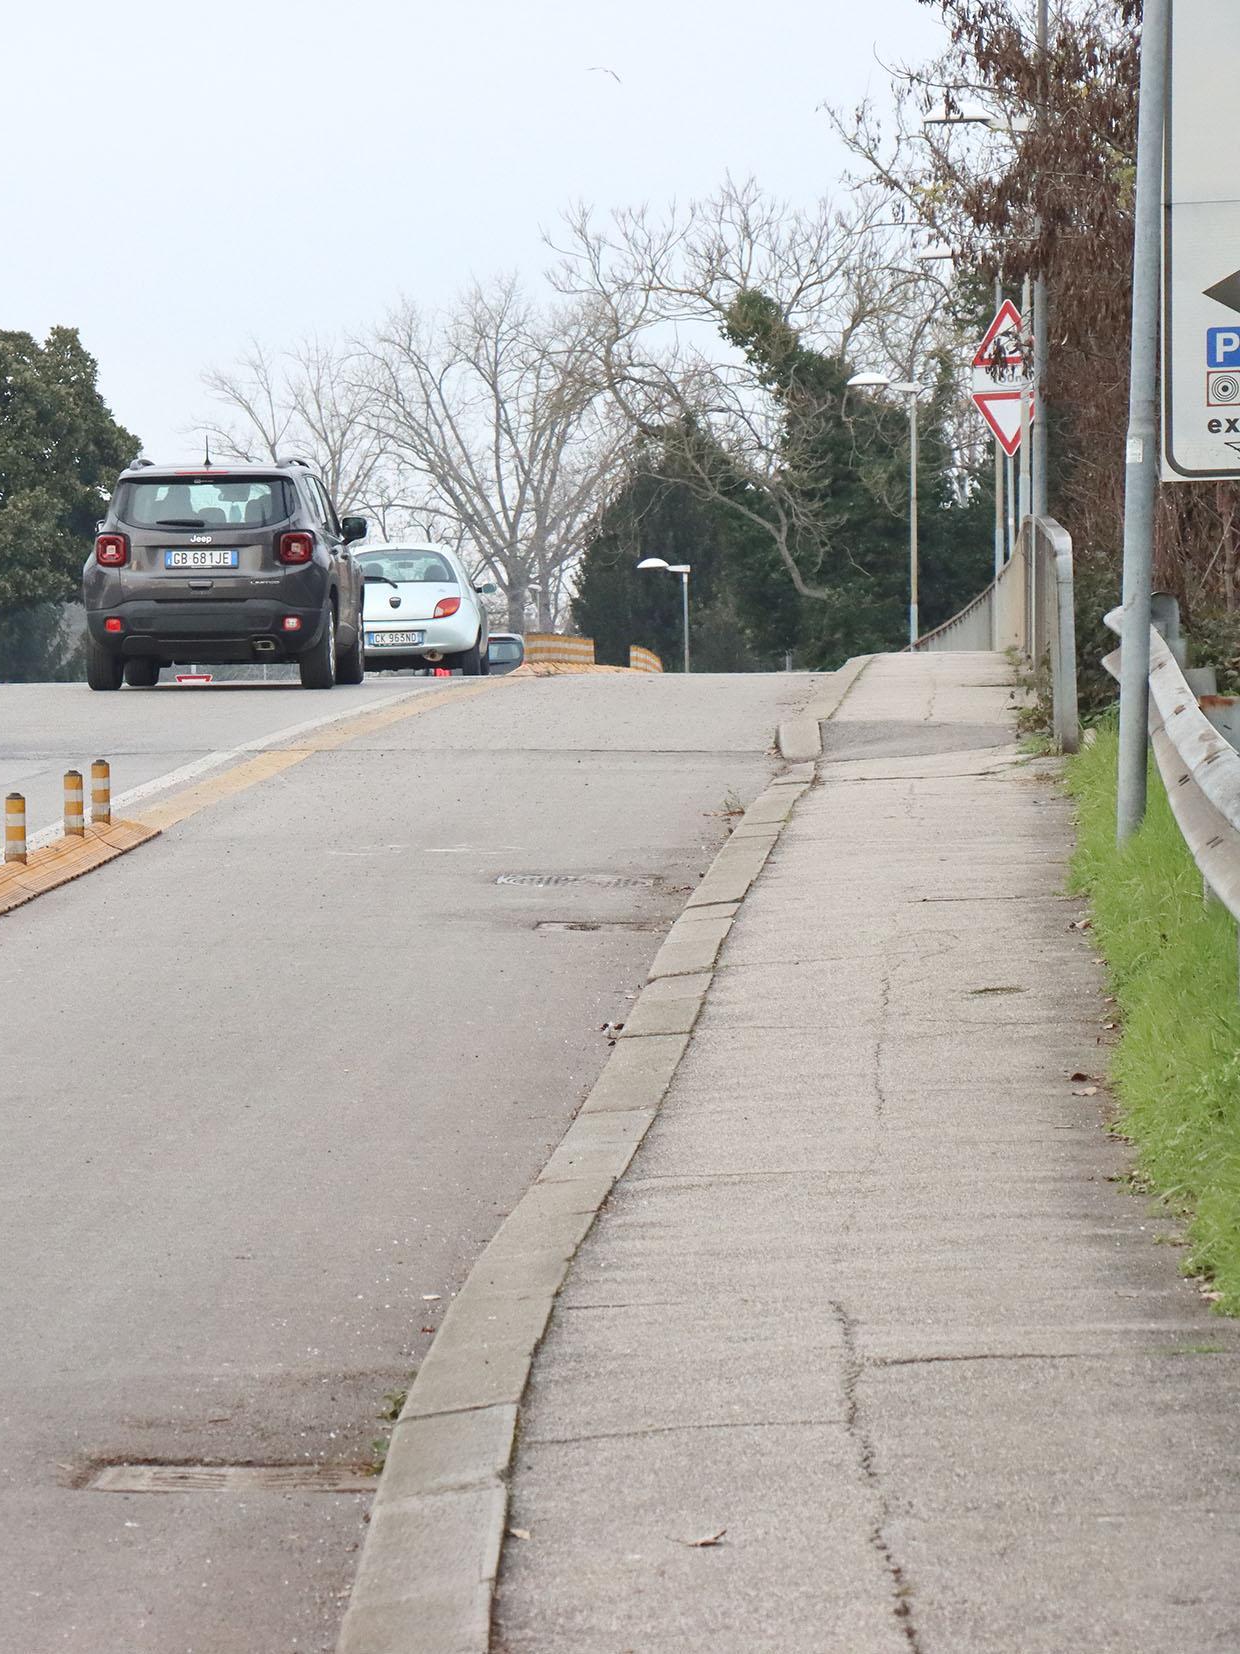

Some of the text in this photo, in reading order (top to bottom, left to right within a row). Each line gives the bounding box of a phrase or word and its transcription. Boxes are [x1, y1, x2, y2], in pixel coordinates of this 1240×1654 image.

[1216, 332, 1240, 362] P
[190, 535, 212, 543] Jeep
[173, 552, 229, 565] GB 681JE
[375, 633, 386, 643] CK
